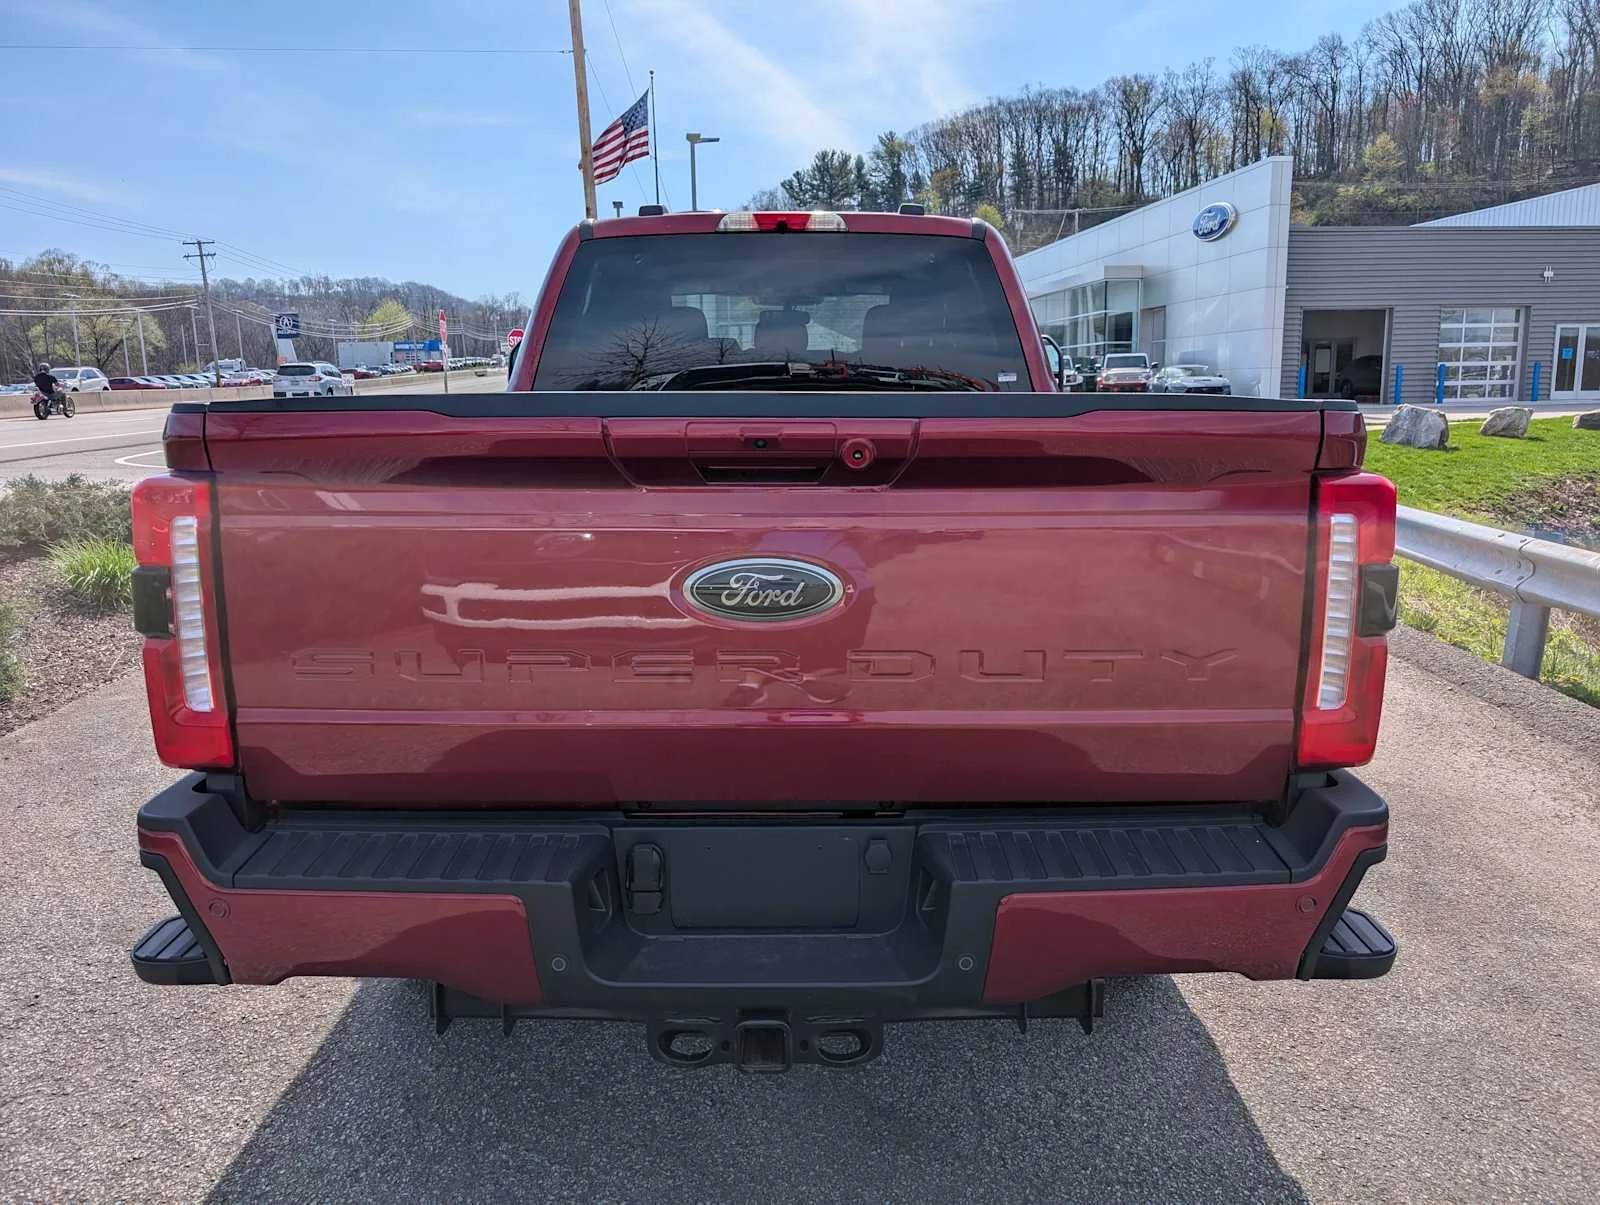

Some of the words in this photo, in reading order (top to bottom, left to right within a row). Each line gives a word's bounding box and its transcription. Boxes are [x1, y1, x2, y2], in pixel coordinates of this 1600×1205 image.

[1197, 211, 1221, 235] Ford
[720, 572, 807, 607] Ford
[289, 648, 803, 683] SUPER
[846, 648, 1241, 683] DUTY
